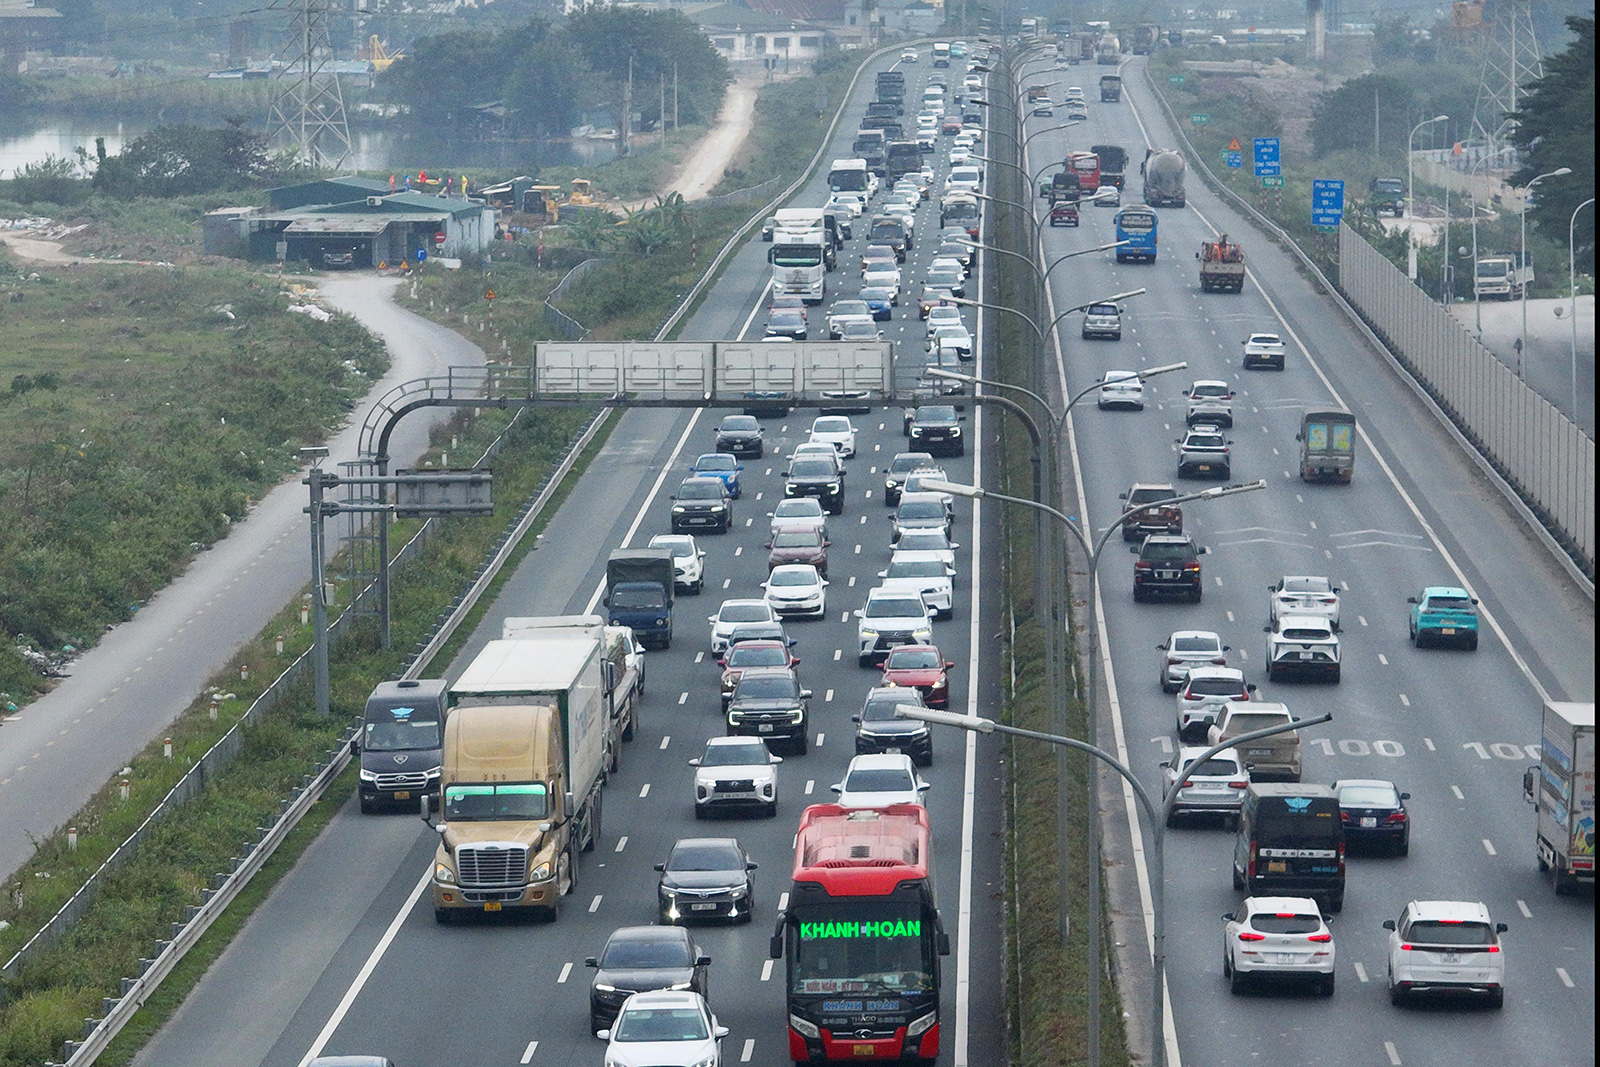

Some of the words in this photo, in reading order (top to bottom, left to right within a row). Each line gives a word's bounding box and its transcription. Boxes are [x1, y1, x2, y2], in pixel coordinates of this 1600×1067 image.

[1310, 738, 1406, 757] 100
[800, 919, 859, 938] KHÁNH
[866, 918, 921, 938] HOÀN
[823, 1000, 862, 1011] KHÁNH
[867, 999, 899, 1011] HOÀN
